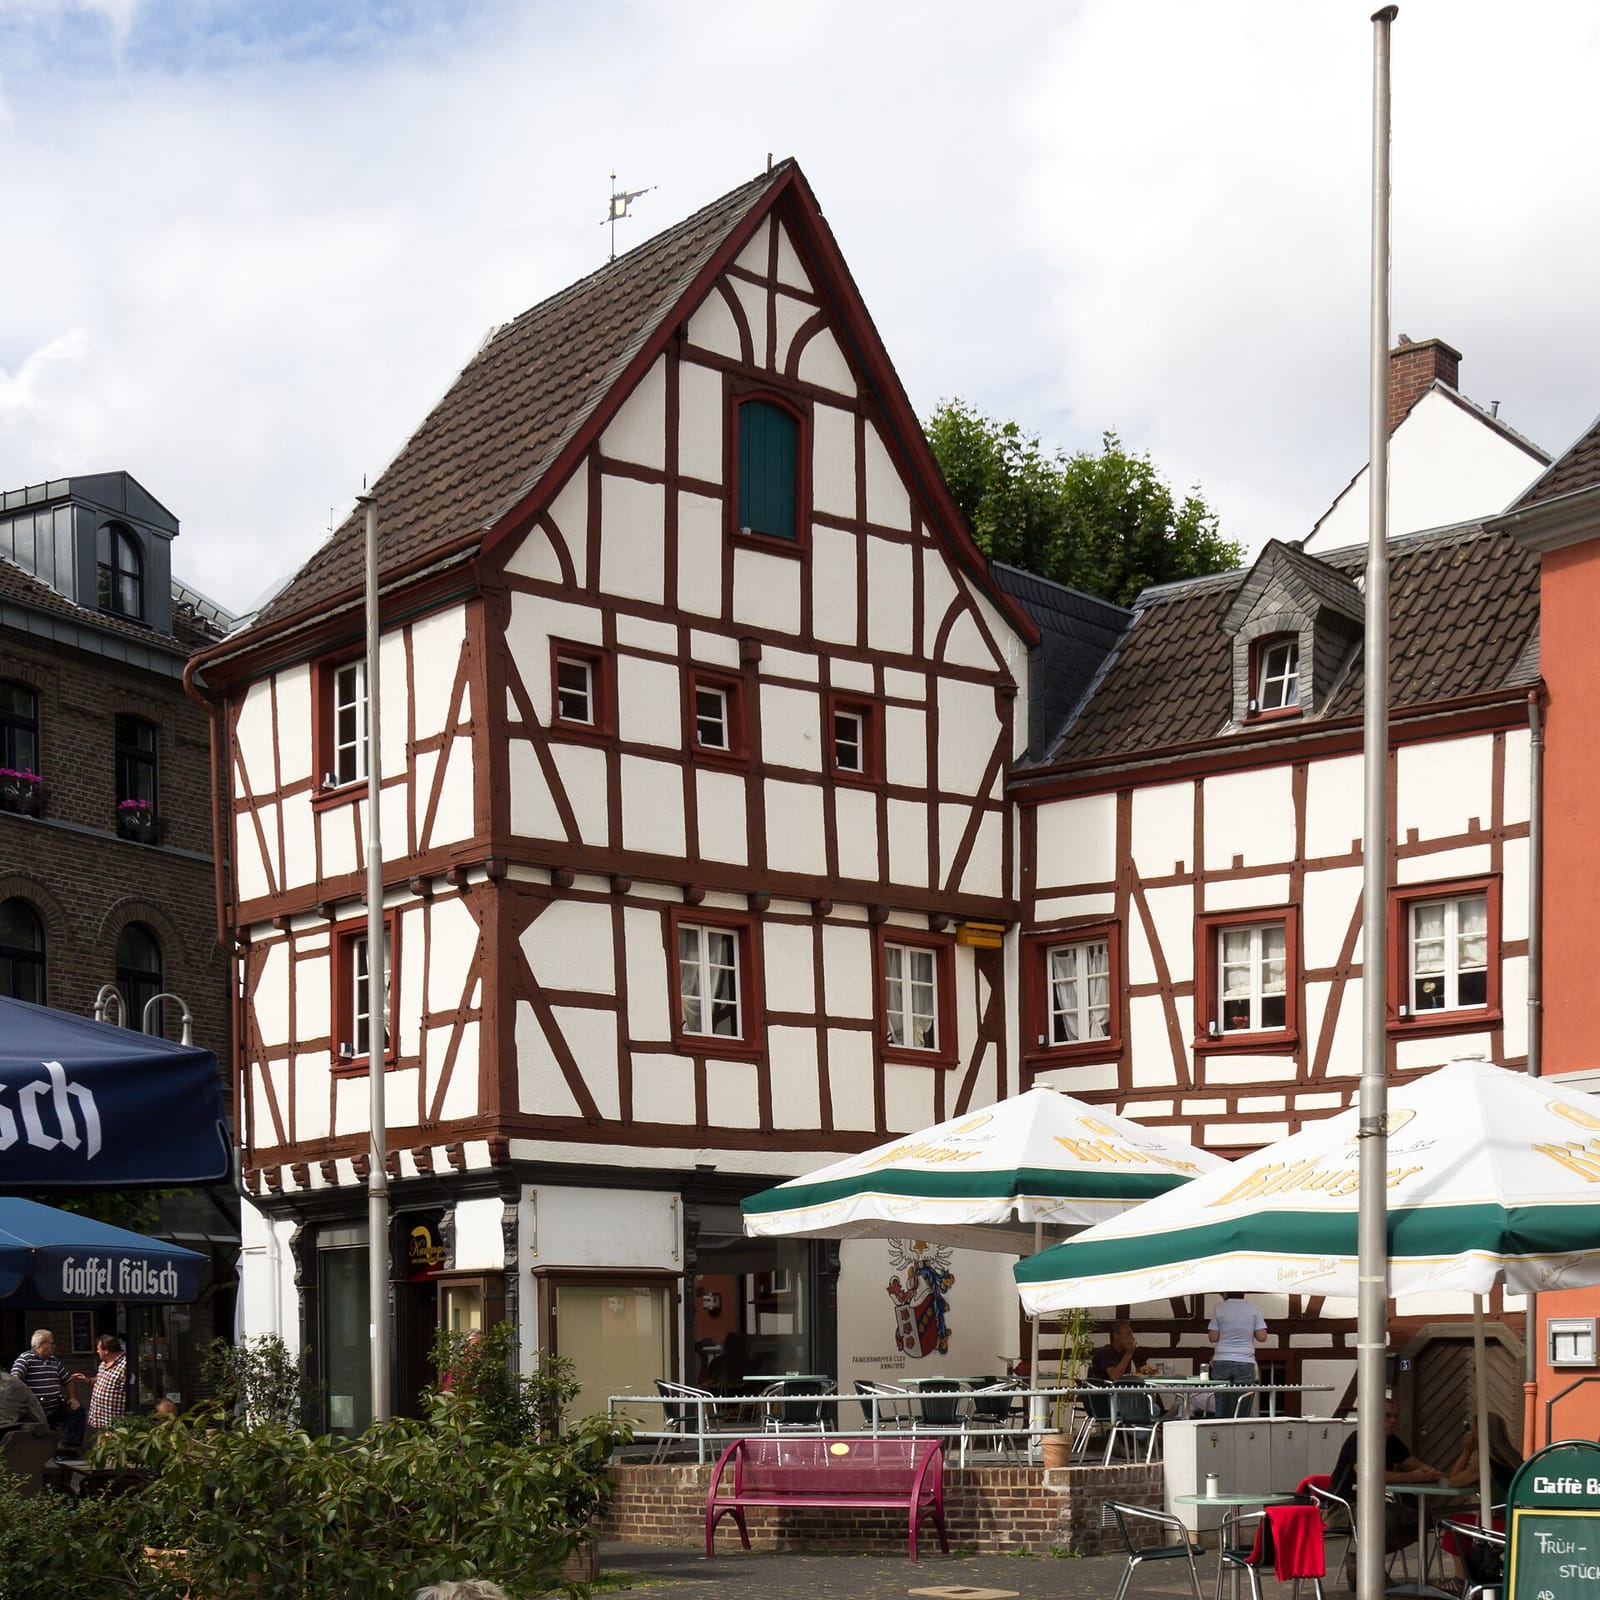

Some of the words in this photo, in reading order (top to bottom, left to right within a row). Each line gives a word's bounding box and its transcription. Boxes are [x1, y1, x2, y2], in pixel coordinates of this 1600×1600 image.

[62, 1257, 115, 1297] Gaffel
[118, 1259, 178, 1299] Kölsch
[1533, 1477, 1582, 1494] Caffè
